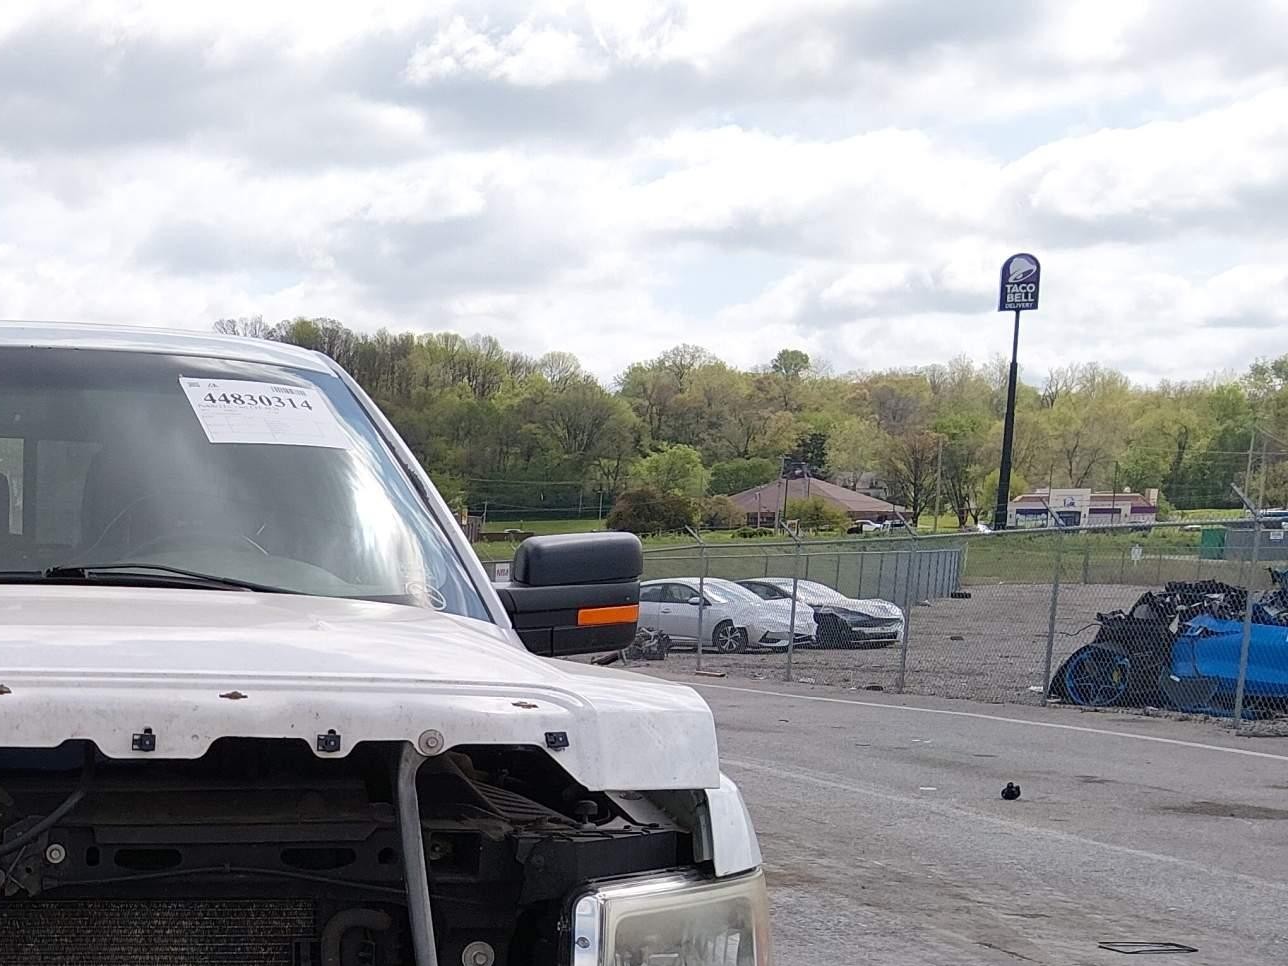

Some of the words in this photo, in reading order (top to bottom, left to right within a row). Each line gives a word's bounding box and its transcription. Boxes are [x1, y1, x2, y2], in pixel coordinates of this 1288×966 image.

[1005, 283, 1036, 293] TACO
[1006, 293, 1034, 303] BELL
[203, 392, 313, 411] 44830314
